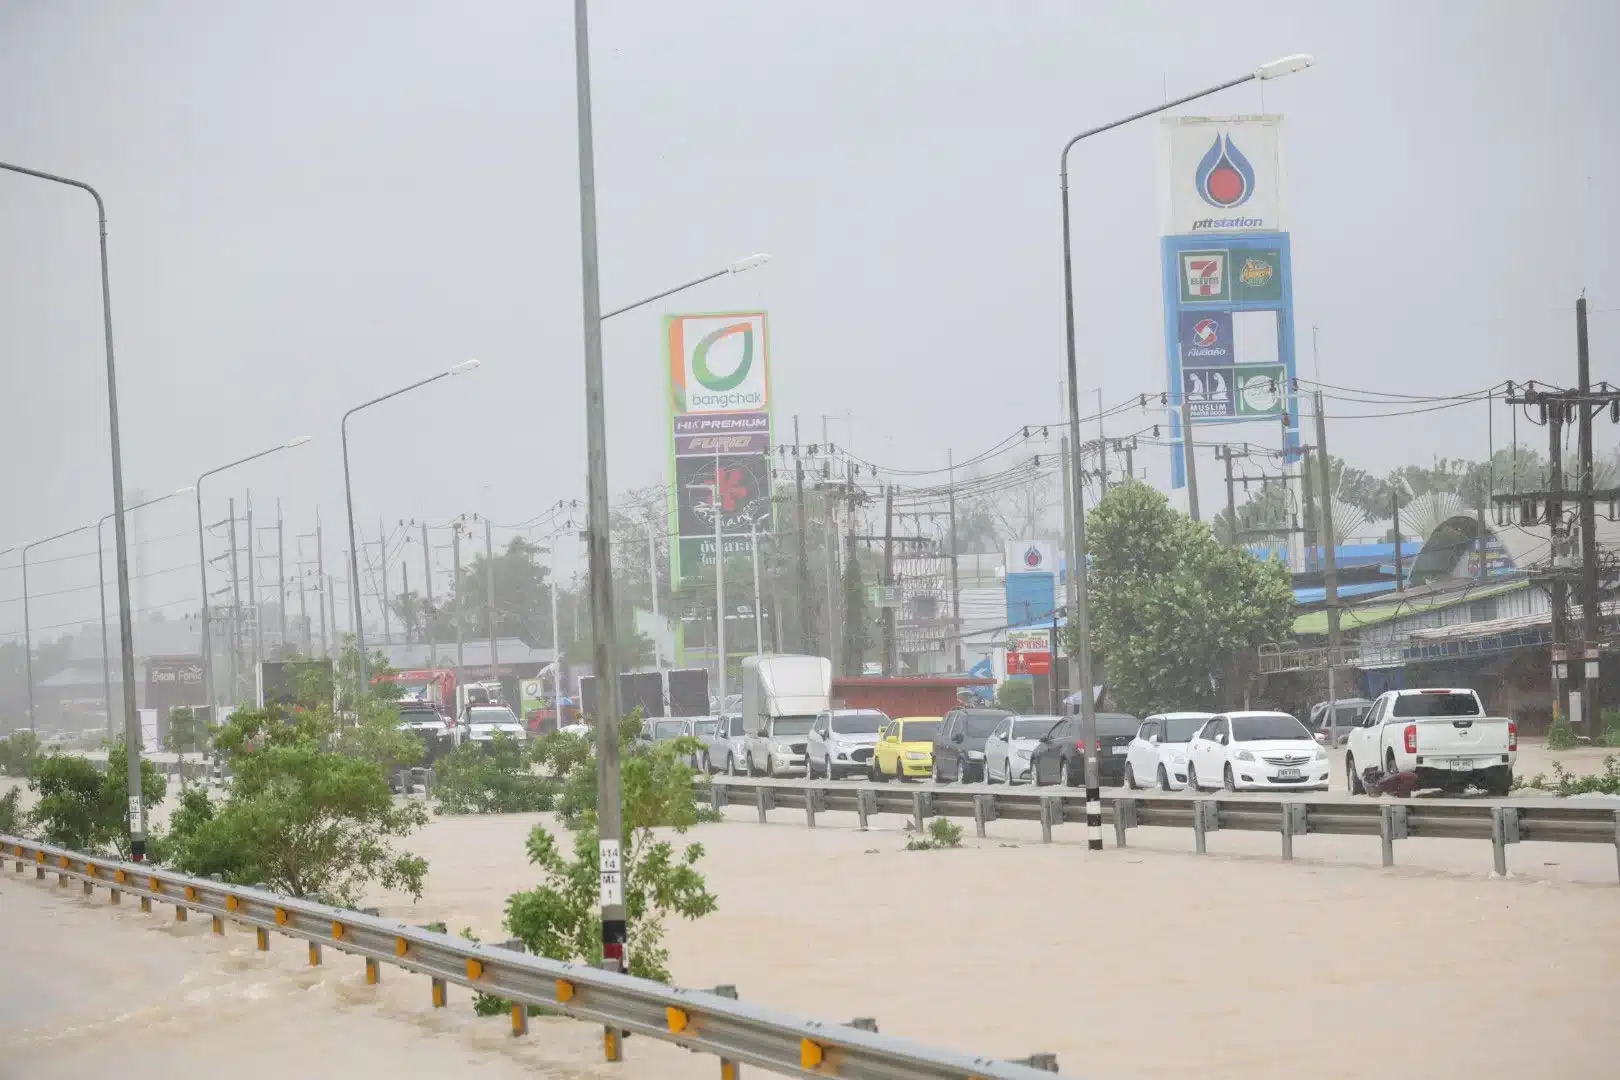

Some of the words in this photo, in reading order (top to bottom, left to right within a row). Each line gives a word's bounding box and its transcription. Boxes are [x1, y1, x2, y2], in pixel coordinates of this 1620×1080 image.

[1192, 218, 1213, 231] ptt
[1213, 216, 1263, 228] station
[1190, 260, 1218, 296] 7
[692, 392, 761, 407] bangchak
[1190, 403, 1227, 412] MUSLIM
[701, 418, 766, 429] PREMIUM
